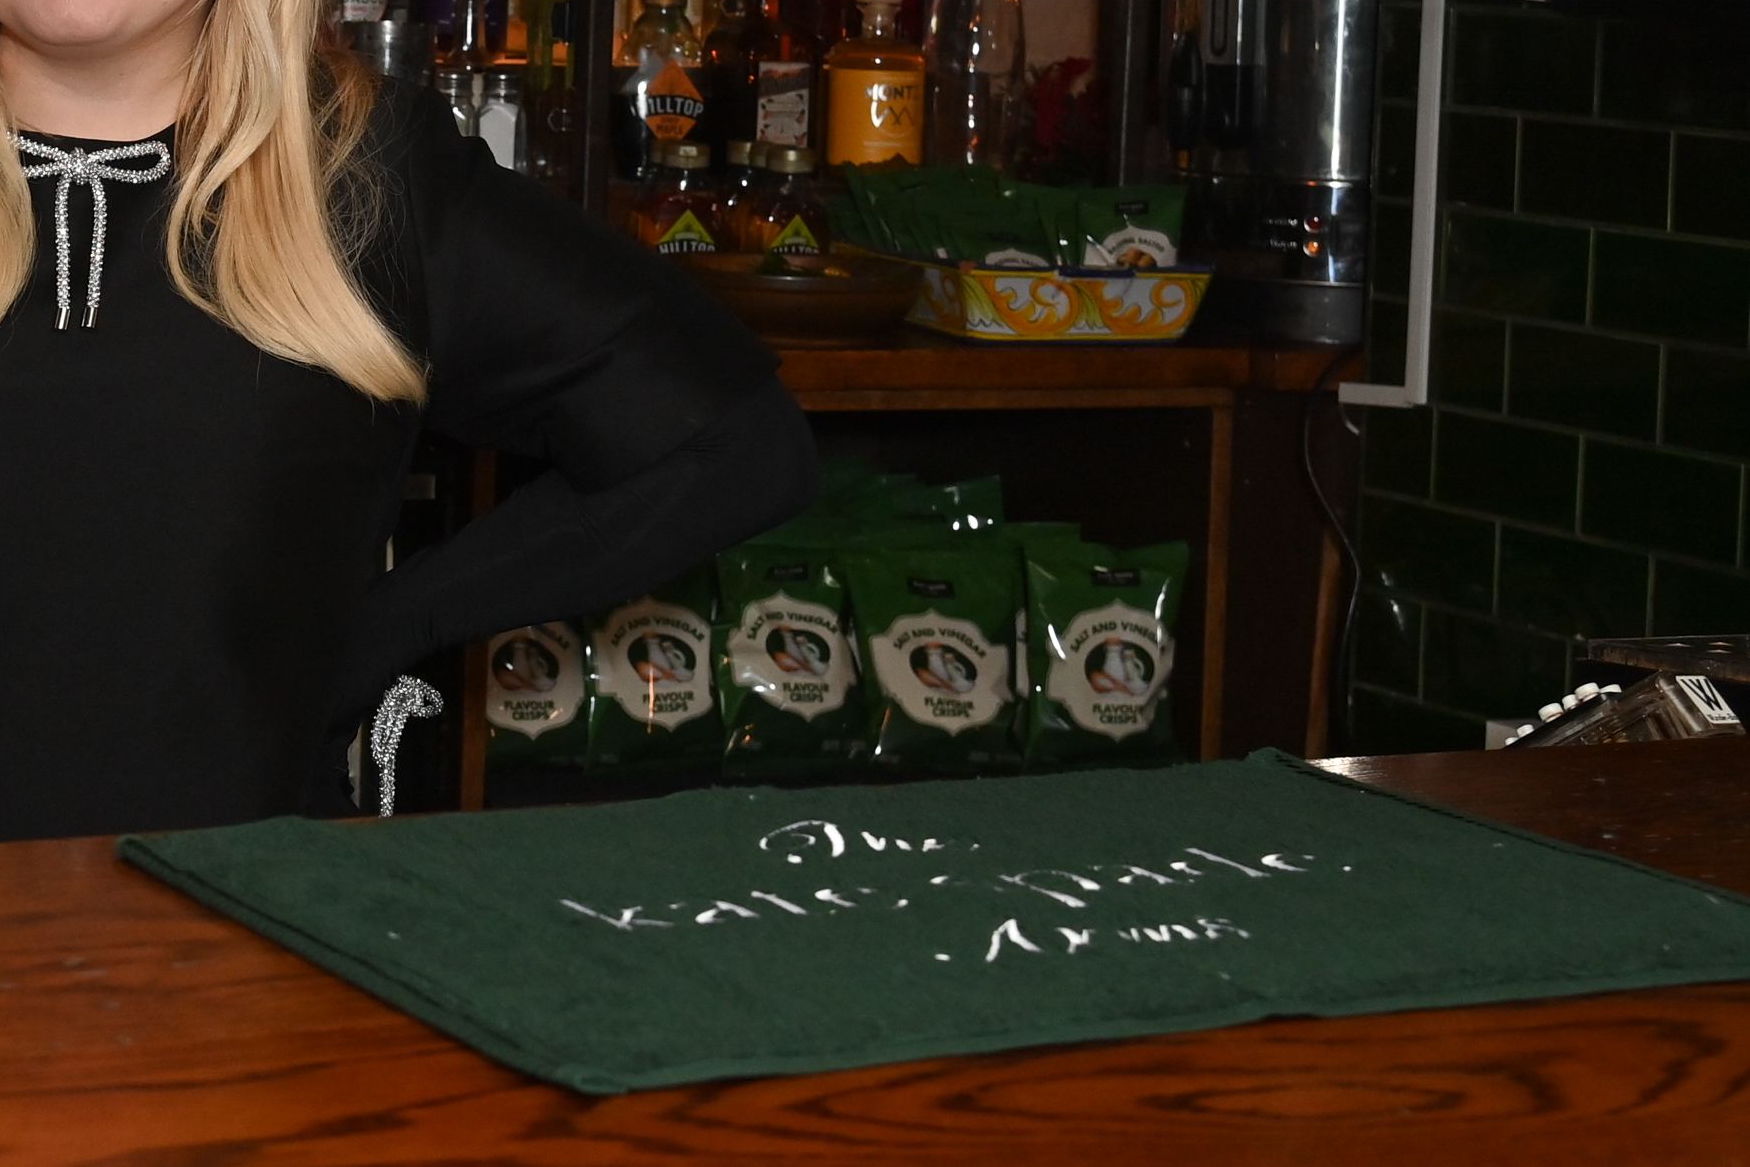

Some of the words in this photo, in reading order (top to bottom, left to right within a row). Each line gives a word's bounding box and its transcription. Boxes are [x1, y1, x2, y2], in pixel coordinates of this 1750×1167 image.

[783, 682, 830, 694] FLAVOUR
[790, 693, 824, 703] CRISPS
[925, 696, 974, 710] FLAVOUR
[1100, 714, 1138, 724] CRISPS
